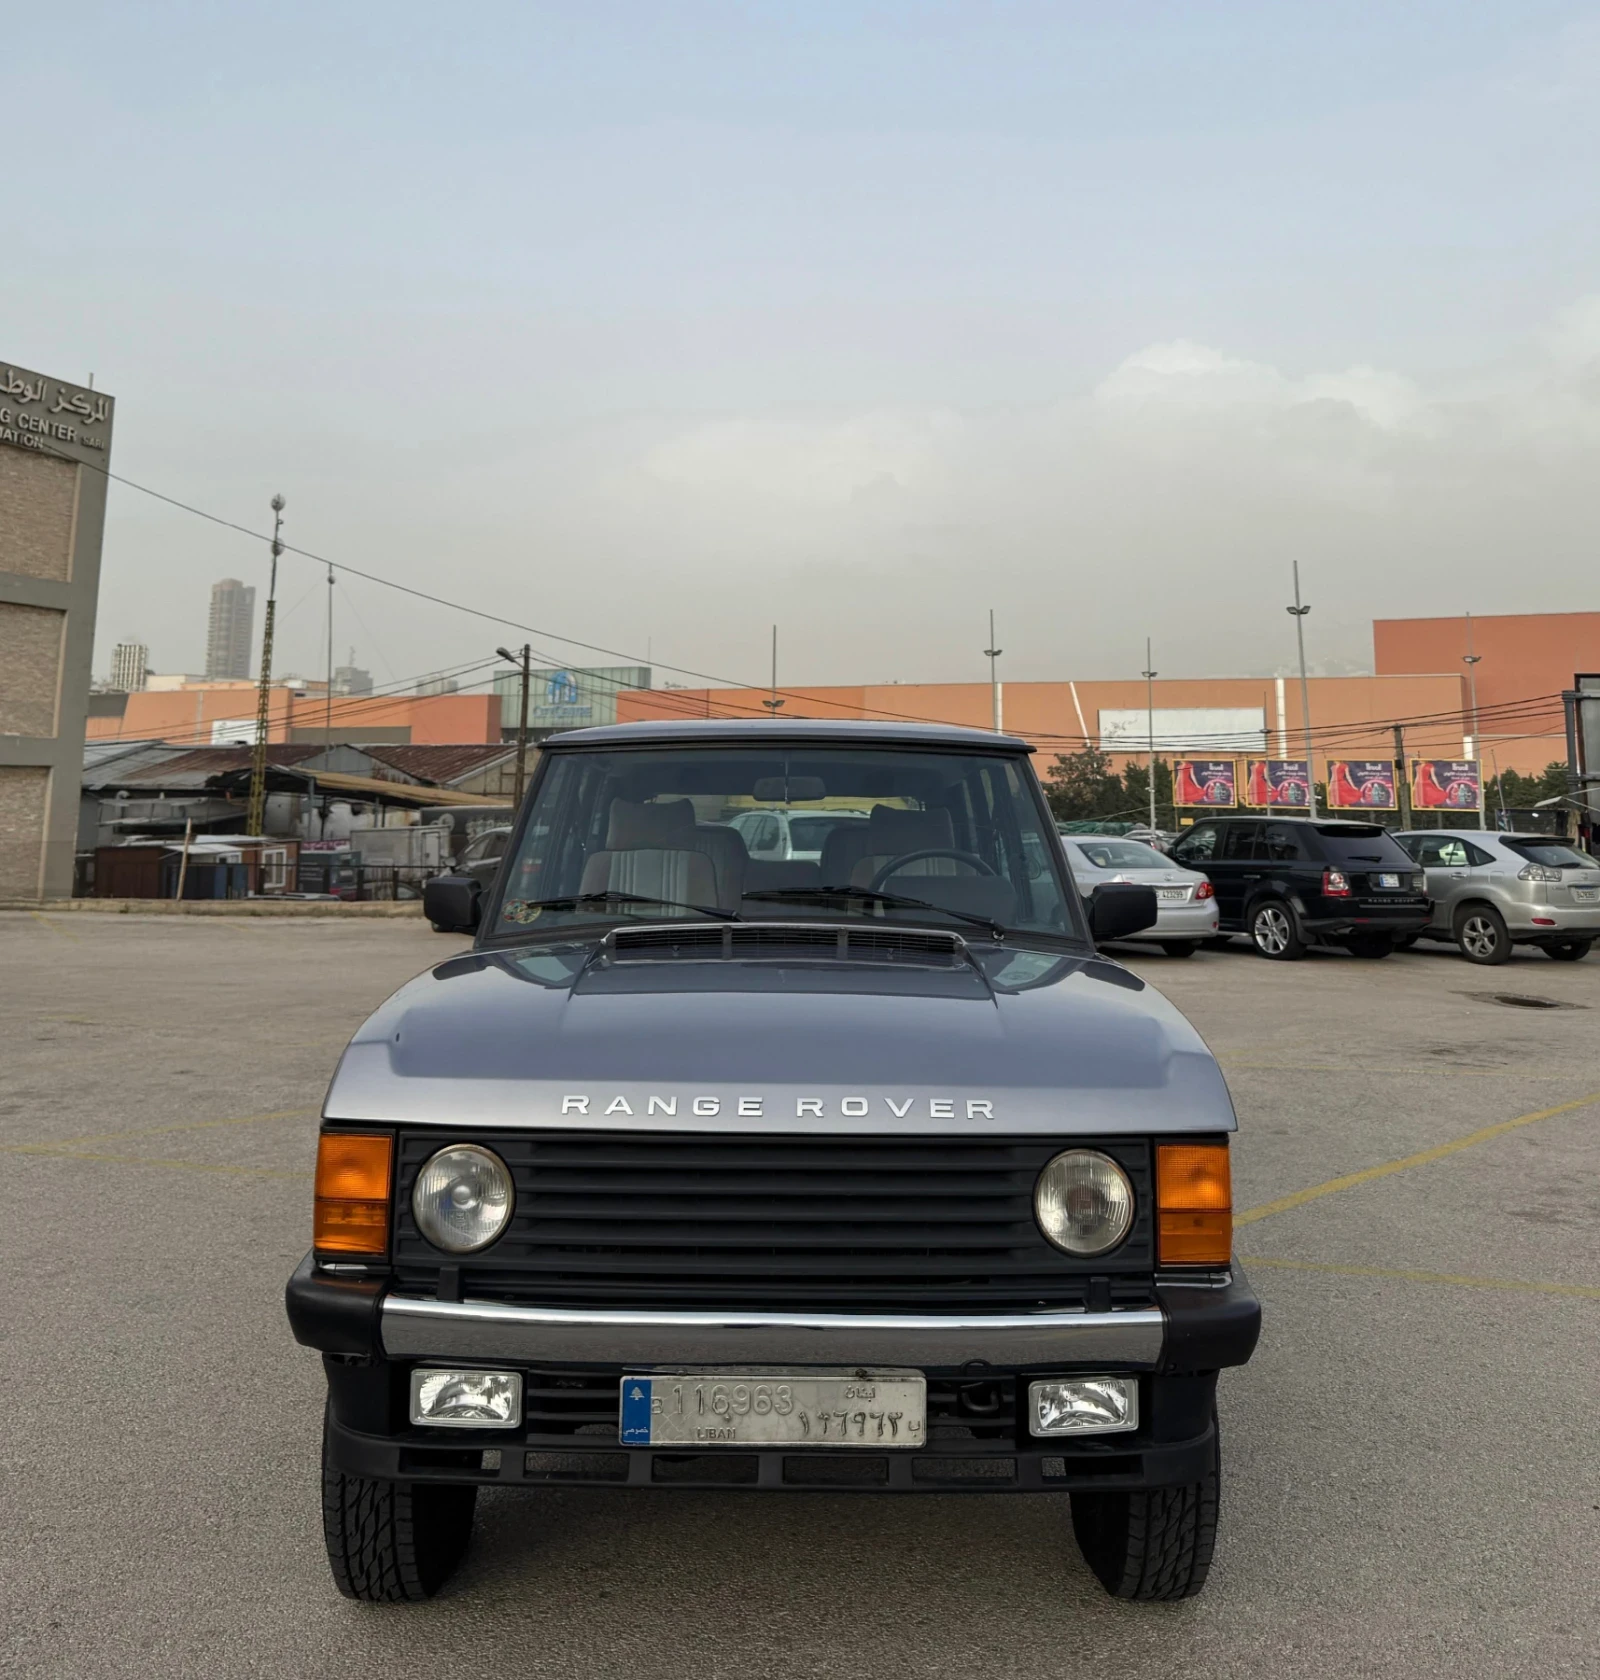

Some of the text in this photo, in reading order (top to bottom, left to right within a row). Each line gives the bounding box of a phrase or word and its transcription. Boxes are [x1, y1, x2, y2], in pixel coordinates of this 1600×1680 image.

[0, 369, 109, 425] المركز الوط
[18, 413, 77, 441] CENTER
[561, 1095, 995, 1119] RANGE ROVER
[651, 1384, 794, 1416] B 116963
[845, 1385, 876, 1402] لبنان
[623, 1426, 649, 1437] خصوصي
[697, 1426, 736, 1439] LIBAN
